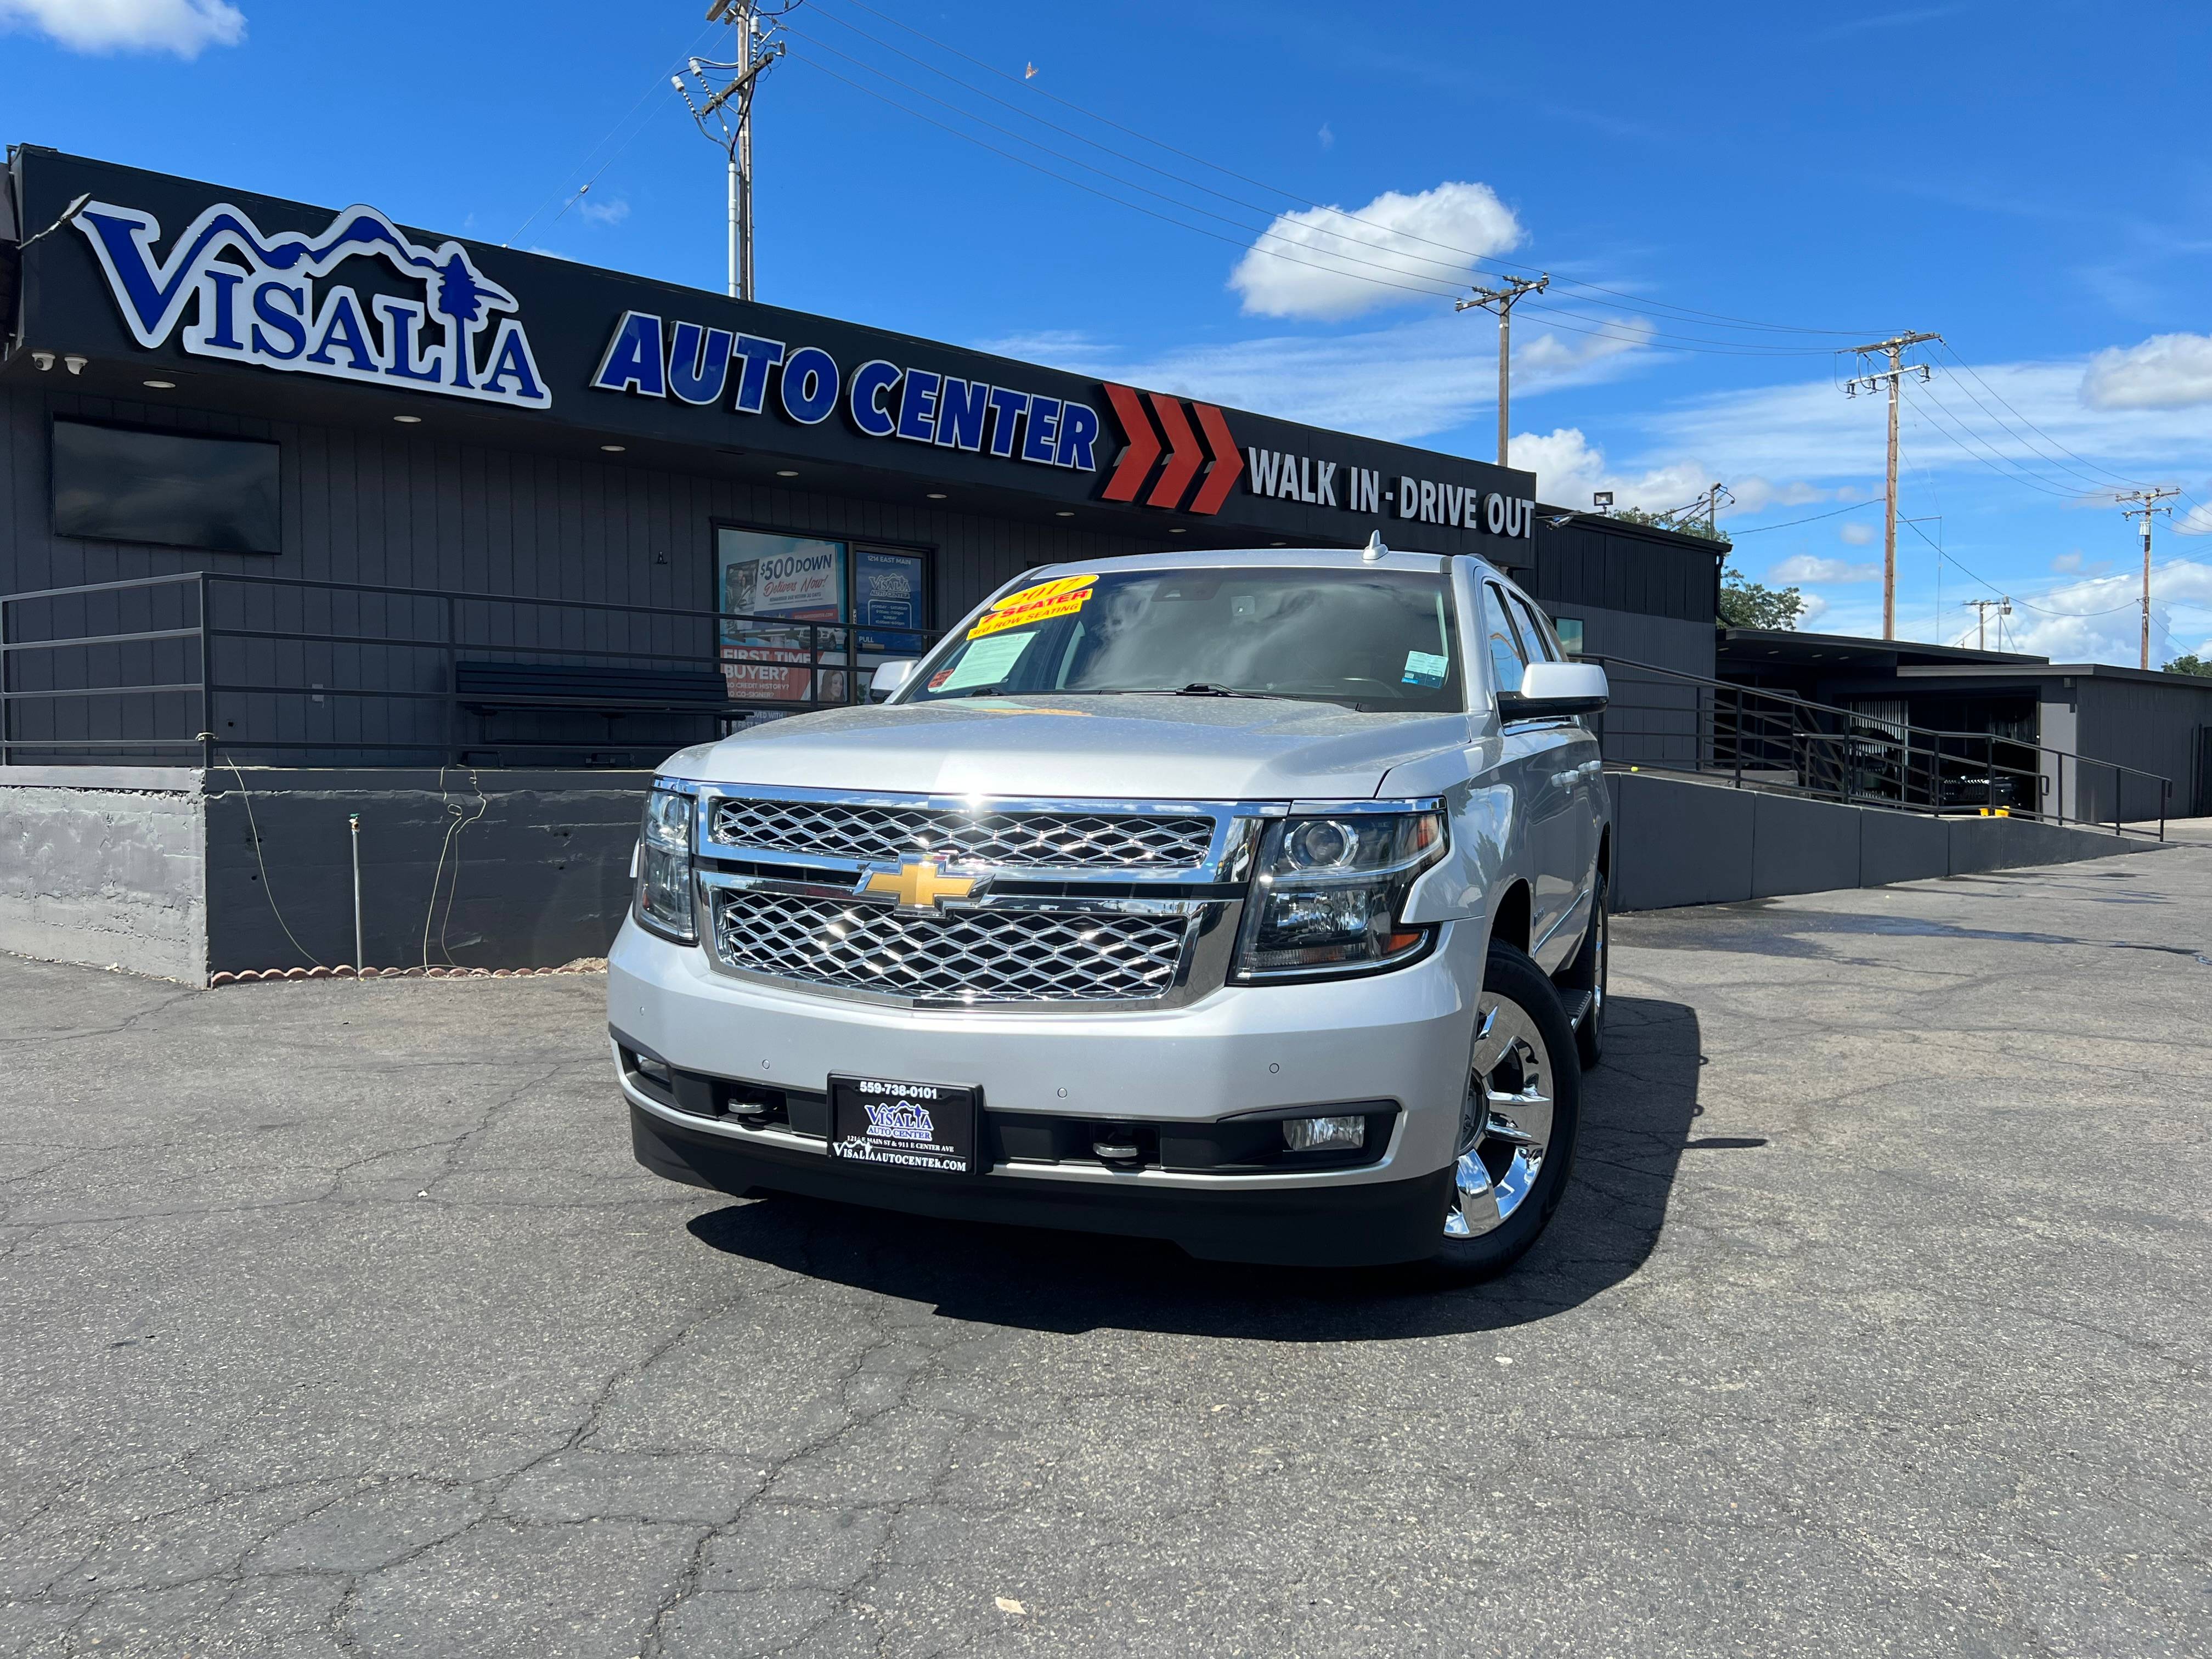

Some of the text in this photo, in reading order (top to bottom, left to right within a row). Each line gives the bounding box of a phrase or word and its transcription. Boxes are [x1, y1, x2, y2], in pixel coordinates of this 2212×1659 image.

[72, 204, 552, 409] VISALIA
[591, 310, 1099, 472] AUTO CENTER
[1248, 447, 1336, 507] WALK
[1350, 466, 1379, 514] IN
[1400, 476, 1476, 529] DRIVE
[1486, 493, 1534, 538] OUT
[760, 554, 832, 580] $500 DOWN
[763, 575, 829, 597] Delivers Now!
[868, 573, 911, 592] VISALIA
[1012, 578, 1080, 605] 2017
[970, 603, 1079, 637] 3rd ROW SEATING
[982, 590, 1088, 624] 7 SEATER
[724, 649, 810, 663] FIRST TIME
[725, 664, 788, 680] BUYER?
[860, 1081, 937, 1099] 559-738-0101
[865, 1100, 934, 1131] VISALIA
[867, 1125, 932, 1141] AUTO CENTER
[833, 1139, 966, 1171] VISALIAAUTOCENTER.COM
